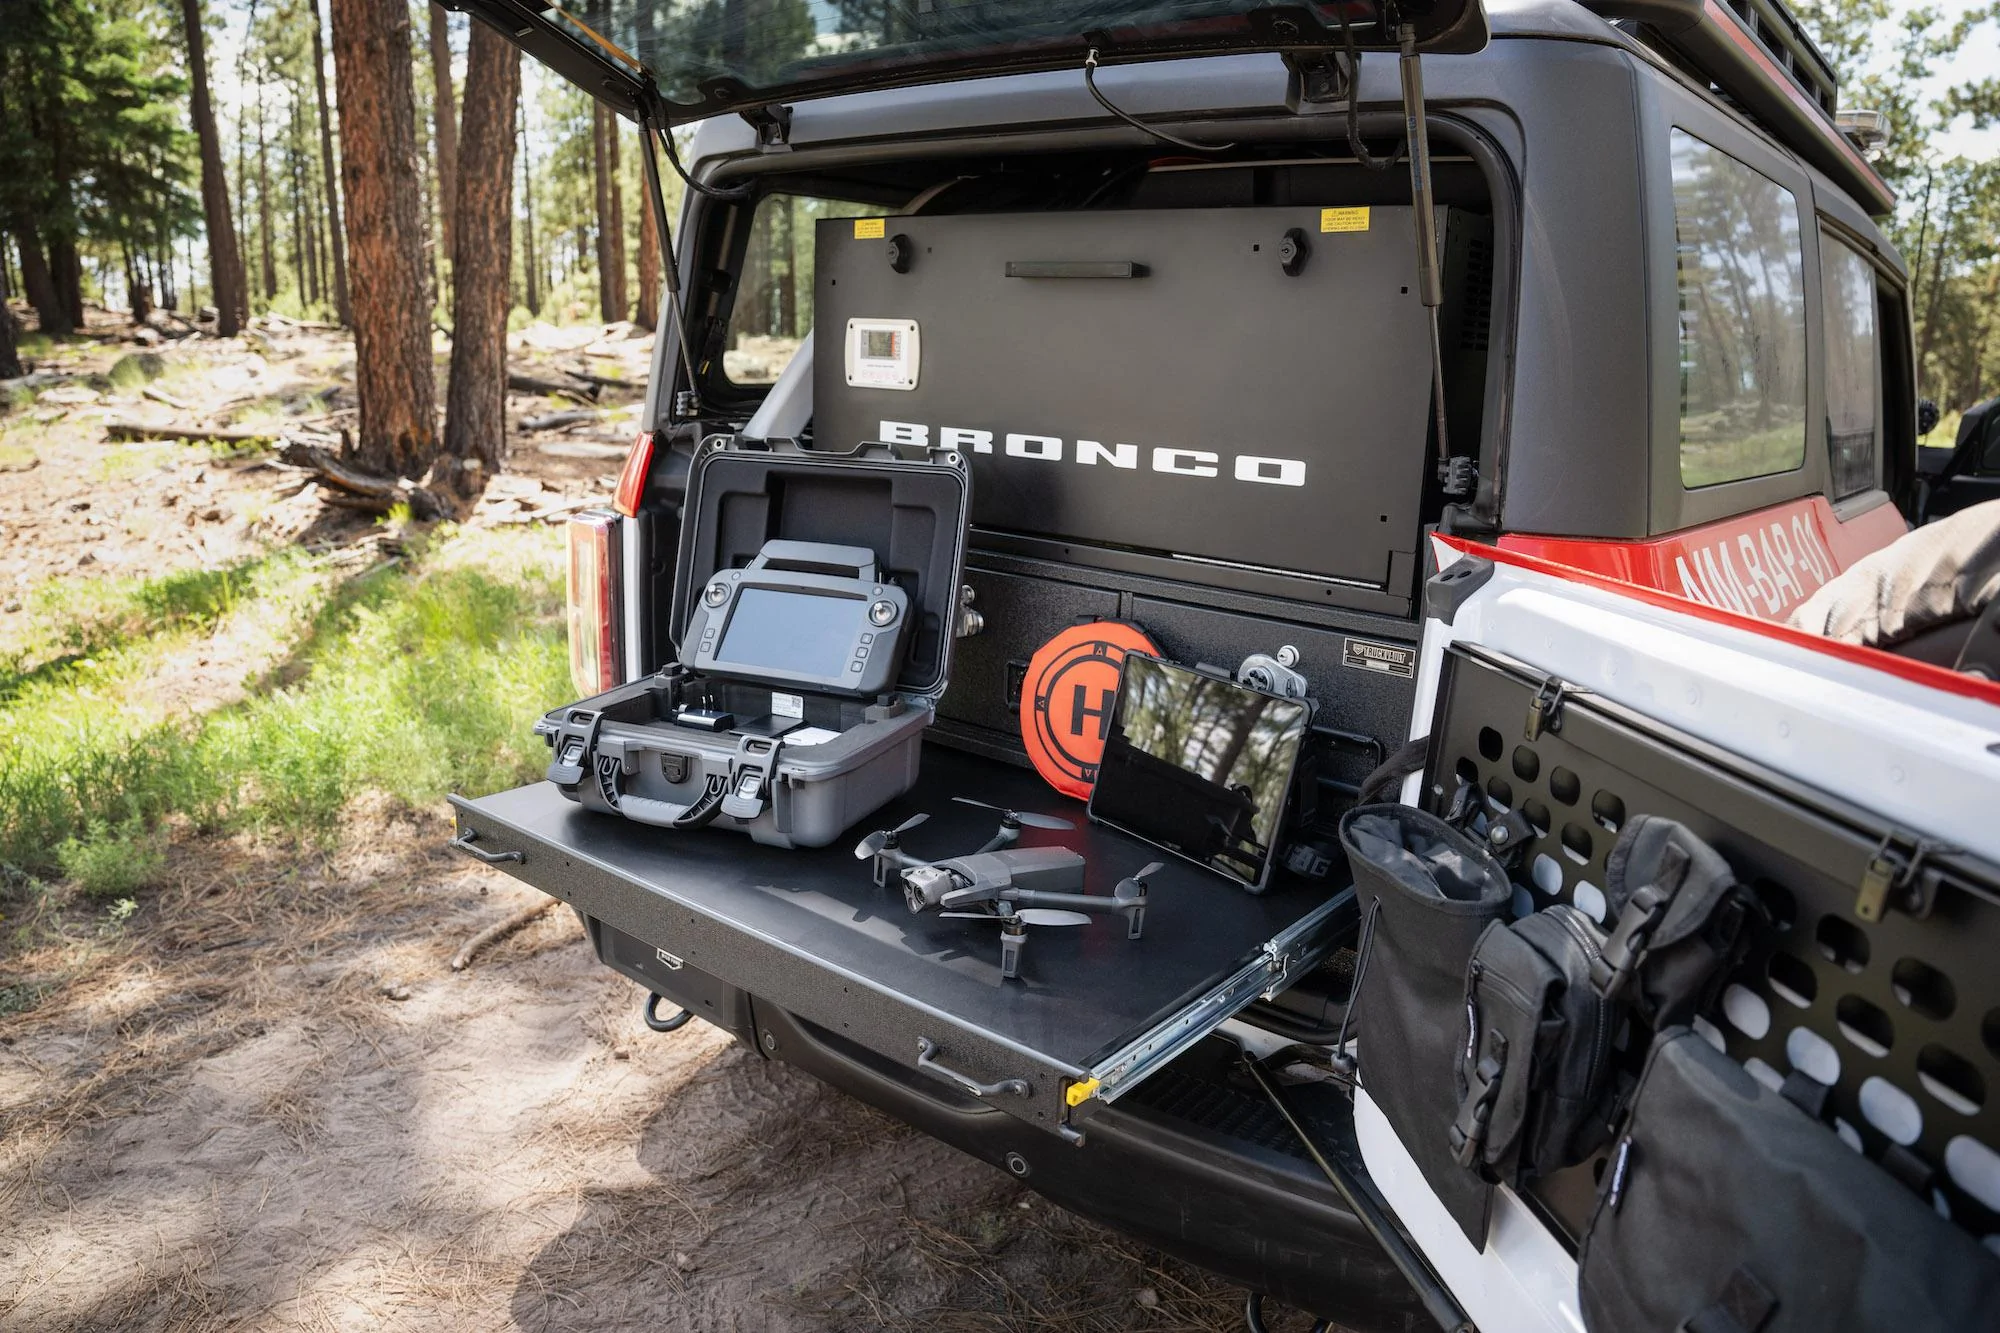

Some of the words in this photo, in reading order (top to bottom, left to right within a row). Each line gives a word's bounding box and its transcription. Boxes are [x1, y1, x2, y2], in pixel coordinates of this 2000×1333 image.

[879, 420, 1307, 487] BRONCO
[1363, 645, 1406, 664] TRUCKVAULT
[1071, 684, 1115, 740] H
